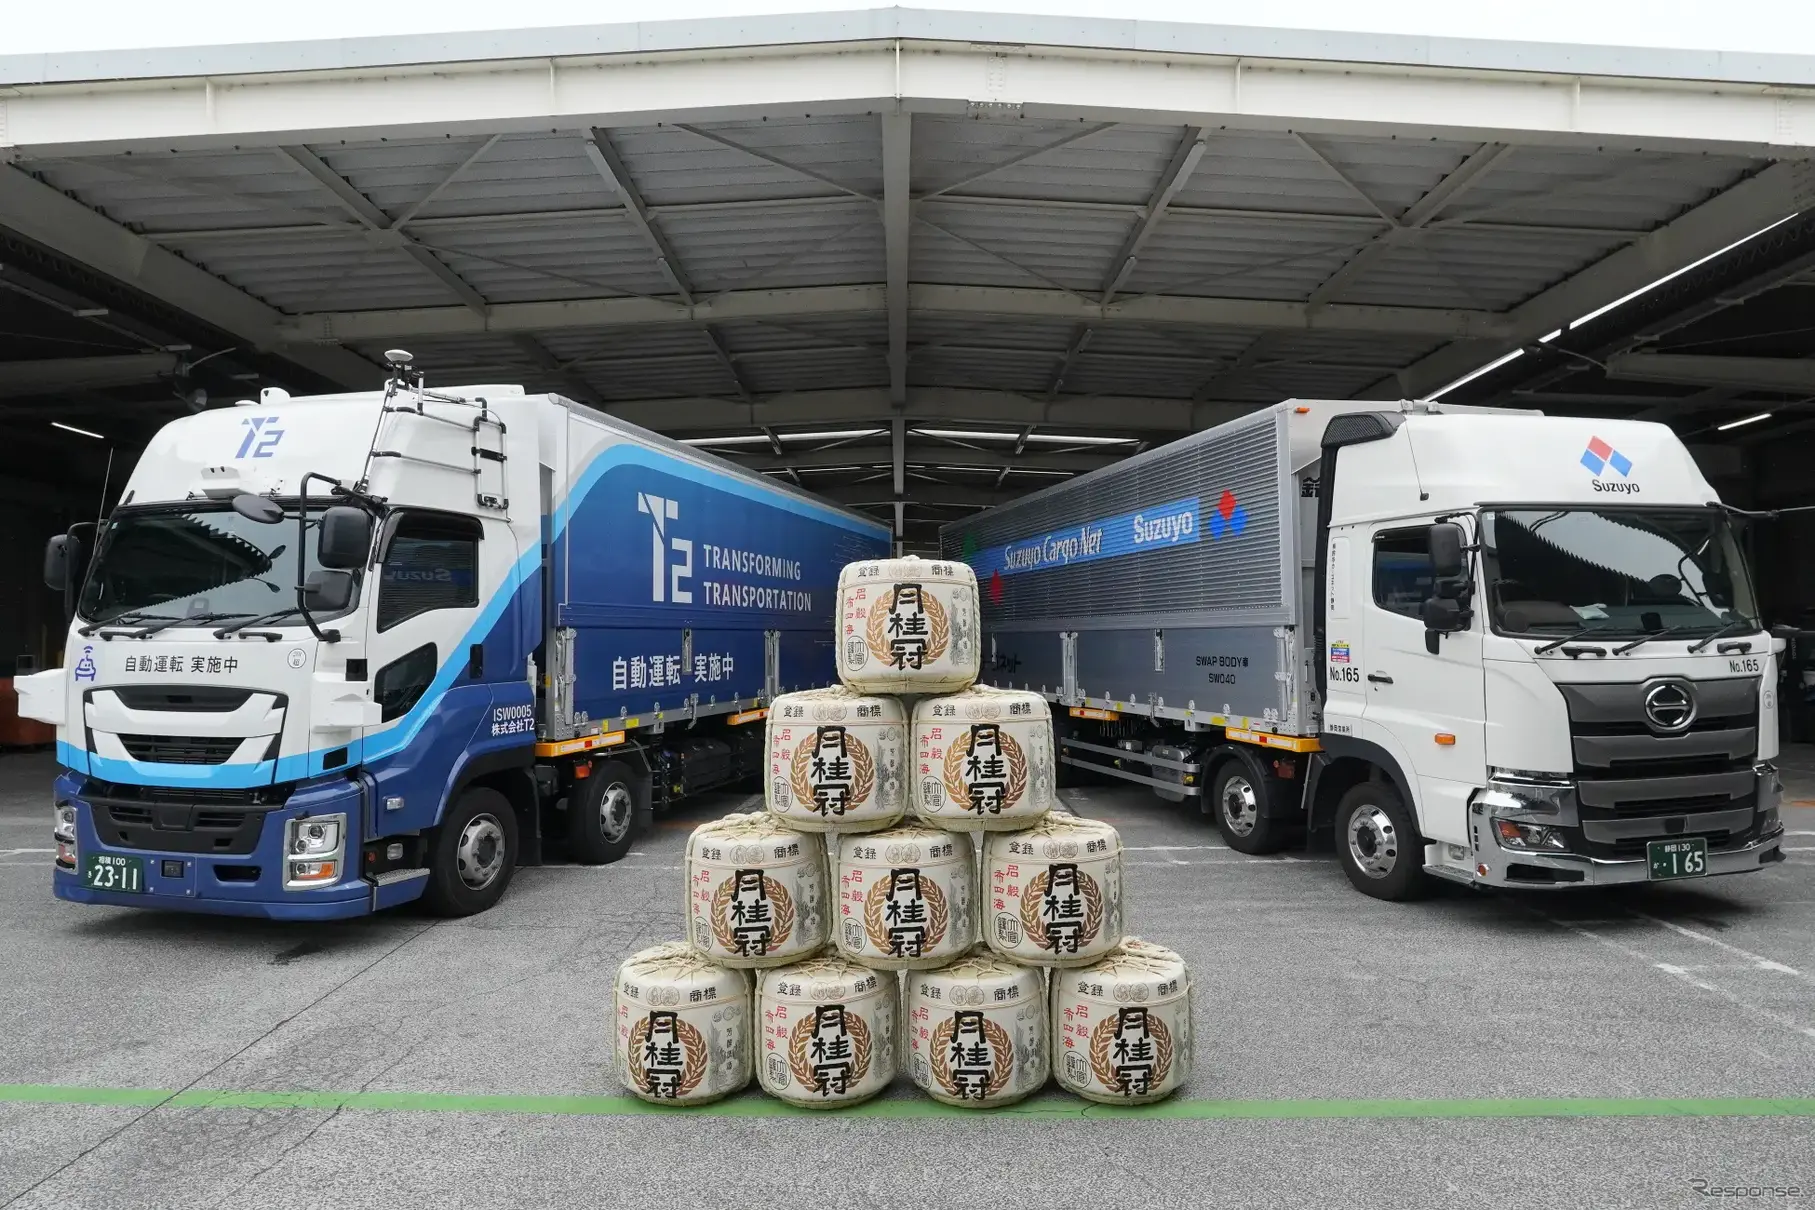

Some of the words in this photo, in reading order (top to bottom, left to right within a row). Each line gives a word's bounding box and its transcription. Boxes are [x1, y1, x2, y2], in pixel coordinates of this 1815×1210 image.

[1592, 479, 1640, 495] Suzuyo
[1133, 511, 1193, 544] Suzuyo
[637, 491, 693, 604] T2
[703, 544, 801, 581] TRANSFORMING
[1003, 545, 1041, 571] Suzuyo
[1043, 536, 1077, 564] Cargo
[1081, 526, 1103, 556] Net
[703, 581, 812, 612] TRANSPORTATION
[887, 583, 929, 671] 月桂冠
[125, 655, 184, 673] 自動運転
[190, 655, 238, 673] 実施中
[612, 654, 681, 691] 自動運転
[694, 652, 734, 682] 実施中
[1195, 656, 1218, 666] SWAP
[1208, 673, 1236, 685] SW040
[1329, 666, 1360, 683] No.165
[1729, 659, 1759, 673] No.165
[491, 717, 535, 737] 株式会社T2
[493, 704, 532, 722] ISW0005
[810, 725, 852, 817] 月桂冠
[965, 724, 1007, 816] 月桂冠
[112, 856, 126, 866] 100
[1678, 843, 1691, 852] 130
[93, 864, 138, 890] 23-11
[730, 869, 772, 957] 月桂冠
[885, 868, 928, 958] 月桂冠
[1042, 863, 1084, 955] 月桂冠
[644, 1010, 684, 1099] 月桂冠
[810, 1004, 853, 1097] 月桂冠
[949, 1010, 992, 1101] 月桂冠
[1113, 1006, 1154, 1097] 月桂冠
